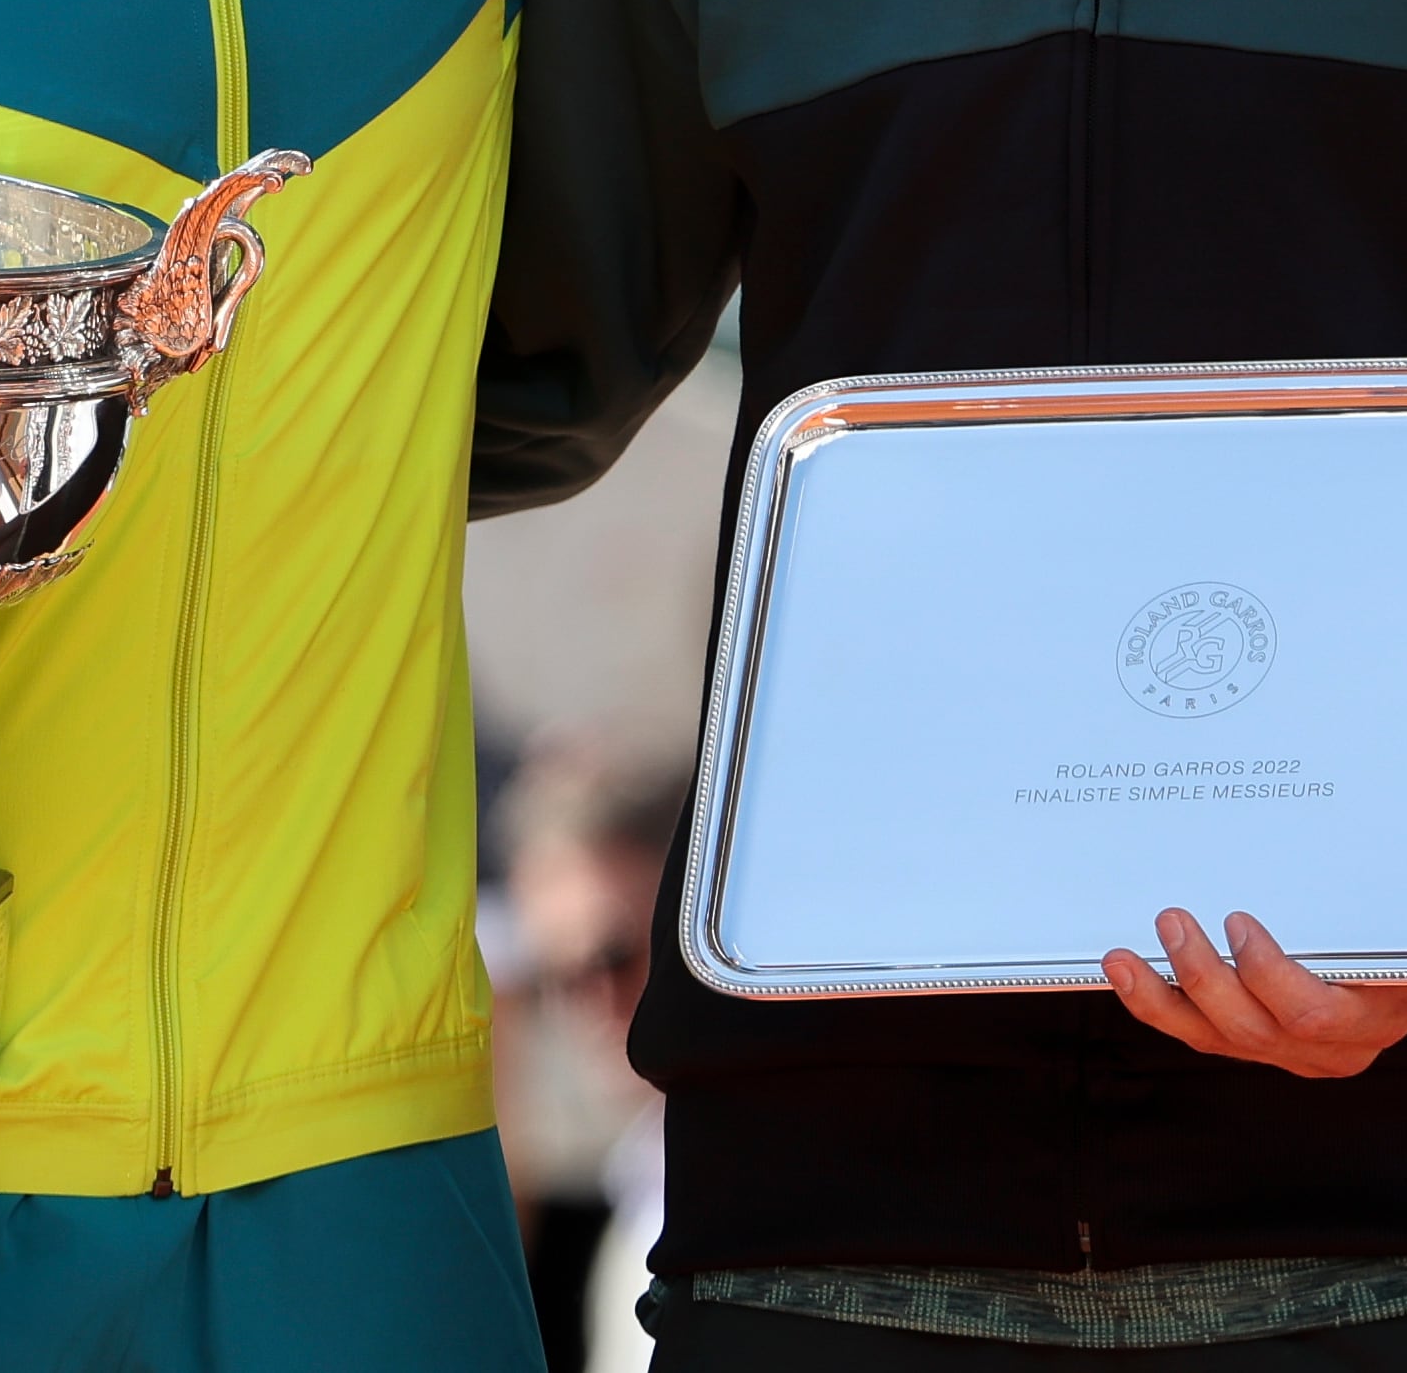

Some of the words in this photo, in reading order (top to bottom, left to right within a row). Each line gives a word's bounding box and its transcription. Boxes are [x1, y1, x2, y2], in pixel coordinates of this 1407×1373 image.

[1125, 590, 1200, 667] ROLAND
[1209, 590, 1269, 663] GARROS
[1142, 683, 1239, 710] PARIS
[1056, 763, 1146, 778] ROLAND
[1154, 761, 1245, 776] GARROS
[1252, 760, 1301, 774] 2022
[1015, 787, 1121, 804] FINALISTE
[1128, 785, 1205, 801] SIMPLE
[1212, 782, 1335, 799] MESSIEURS
